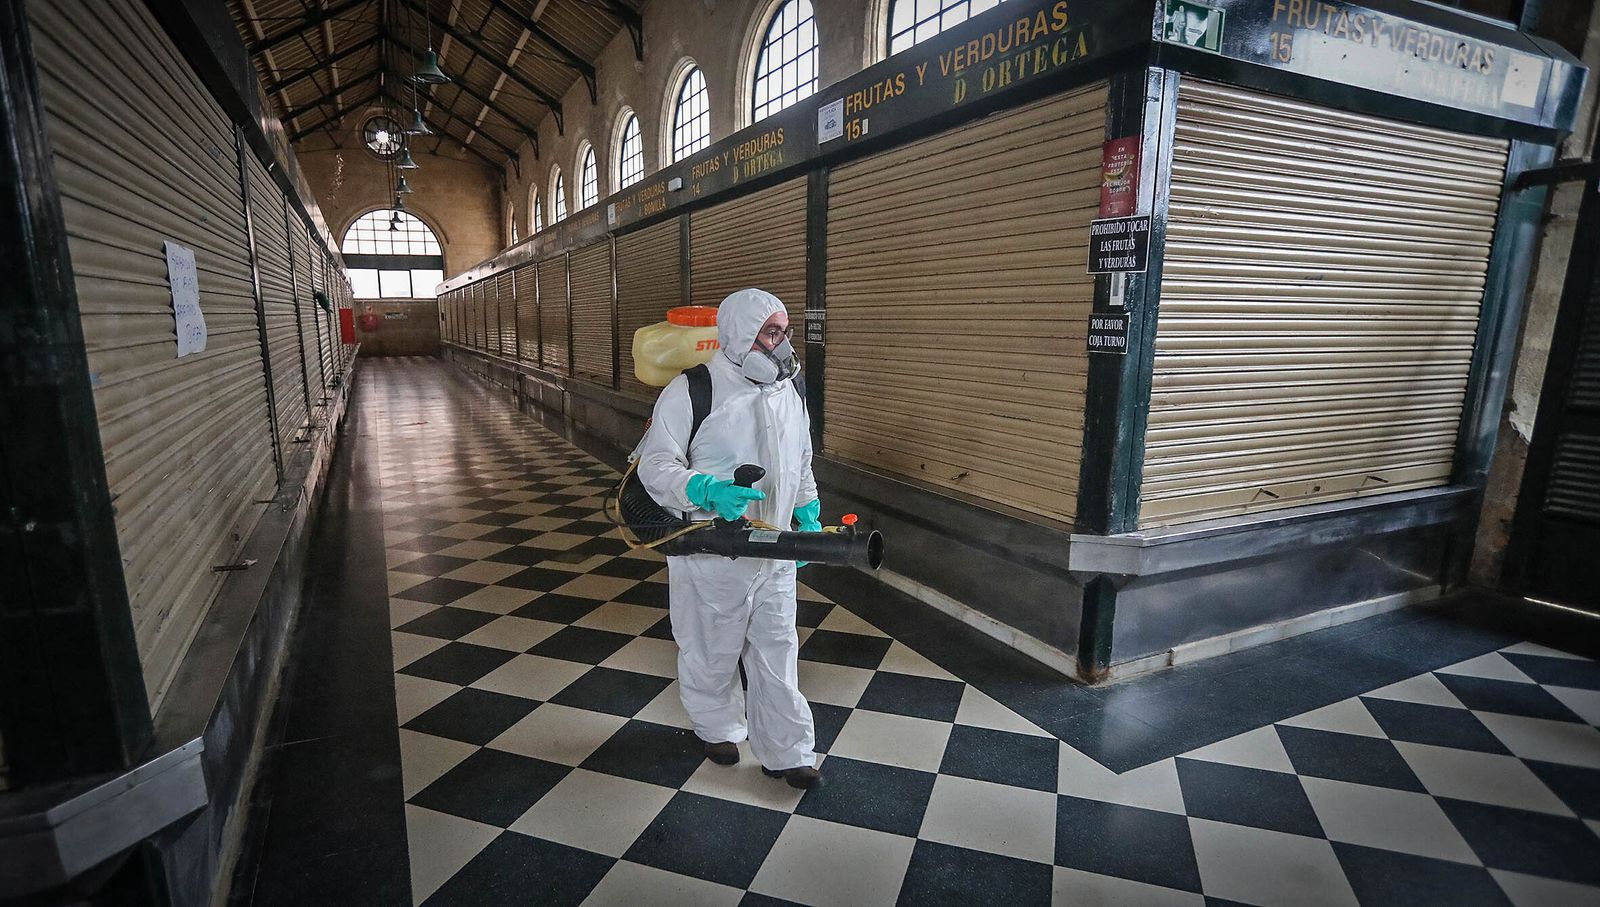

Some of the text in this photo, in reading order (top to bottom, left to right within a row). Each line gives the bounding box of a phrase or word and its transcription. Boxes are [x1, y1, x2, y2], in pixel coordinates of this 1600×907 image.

[1270, 31, 1293, 63] 15
[1271, 0, 1495, 76] FRUTAS Y VERDURAS
[845, 1, 1069, 117] FRUTAS Y VERDURAS
[953, 31, 1089, 105] D ORTEGA
[845, 117, 860, 142] 15
[691, 127, 785, 178] FRUTAS Y VERDURAS
[744, 147, 785, 178] ORTEGA
[638, 181, 666, 203] VERDURAS
[692, 184, 701, 197] 14
[1091, 219, 1148, 235] PROHIBIDO TOCAR
[1100, 238, 1136, 252] LAS FRUTAS
[1099, 256, 1136, 269] Y VERDURAS
[1091, 318, 1124, 330] POR FAVOR
[1088, 335, 1125, 347] COJA TURNO
